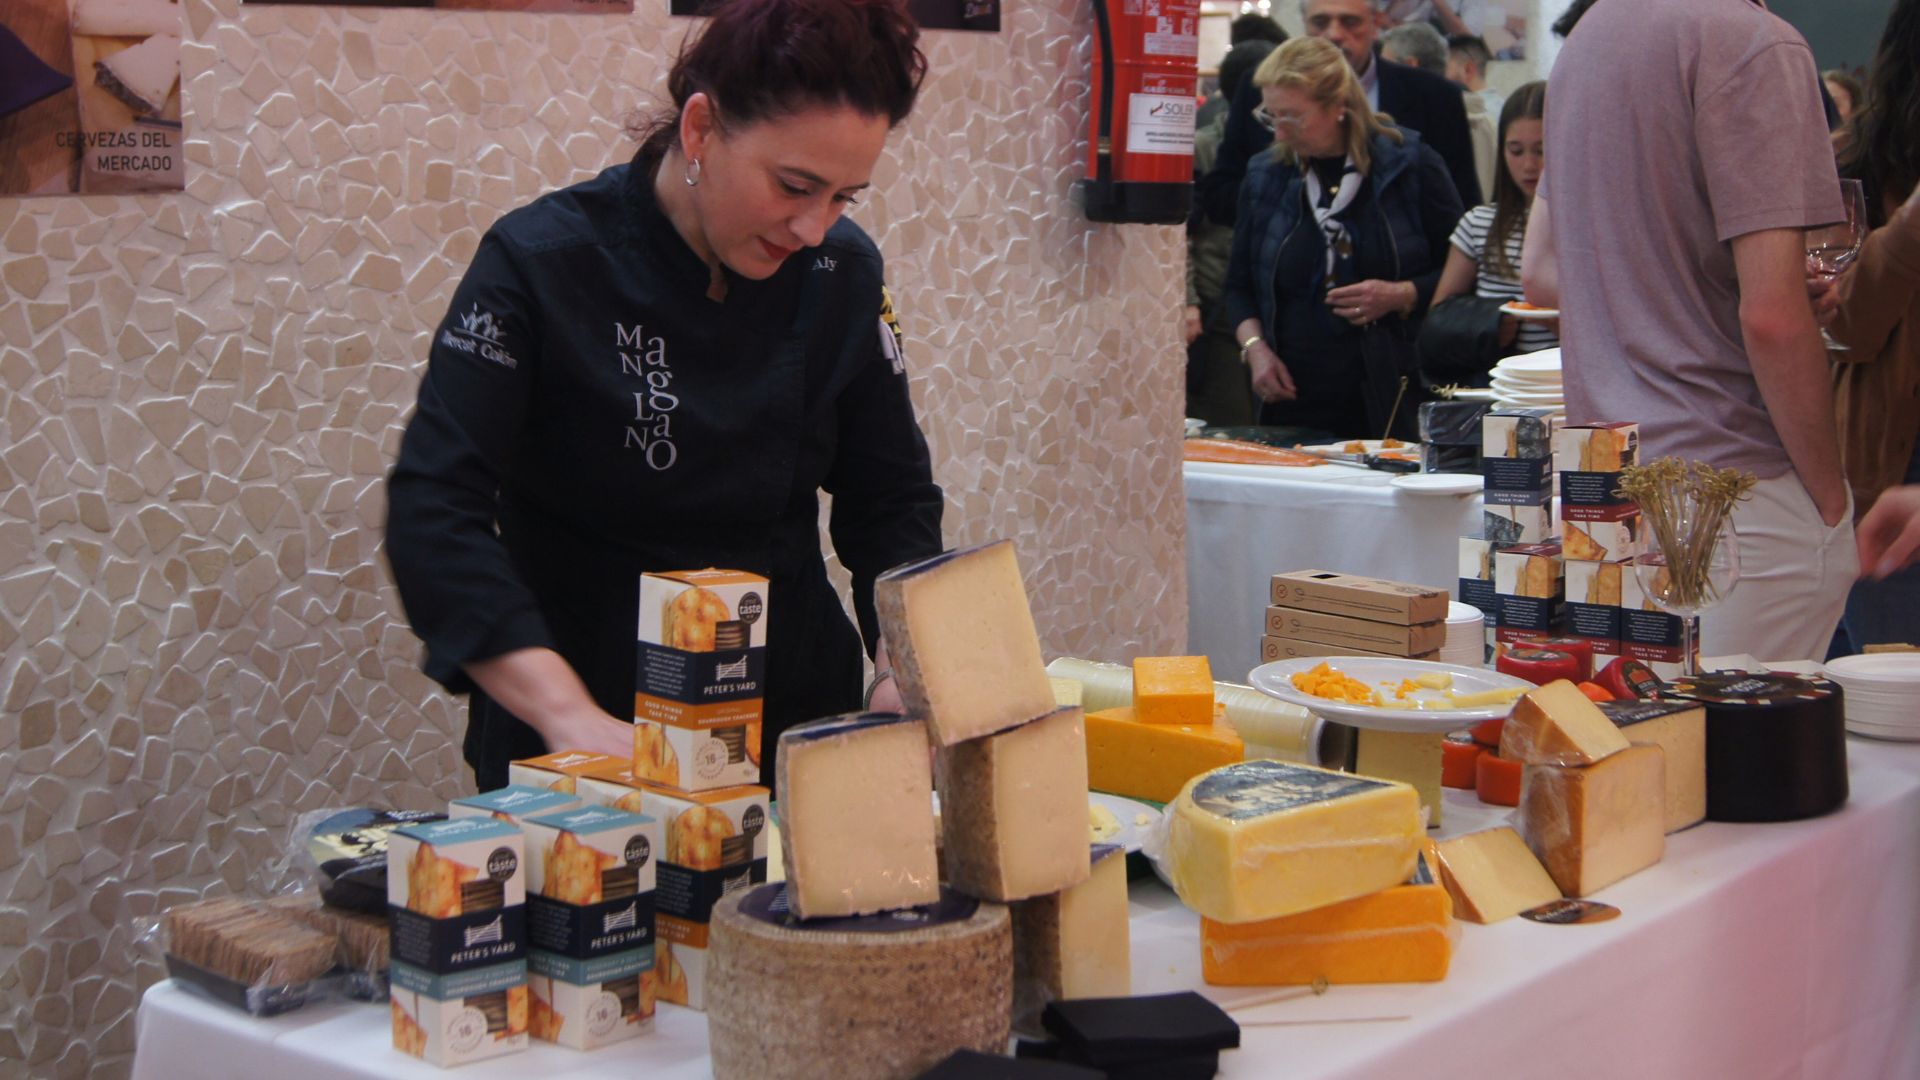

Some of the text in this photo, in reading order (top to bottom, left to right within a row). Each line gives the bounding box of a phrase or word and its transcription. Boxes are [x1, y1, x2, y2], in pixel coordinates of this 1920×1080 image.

[56, 132, 172, 148] CERVEZAS DEL
[97, 155, 172, 171] MERCADO
[812, 256, 838, 271] Aly
[740, 604, 762, 615] taste
[703, 681, 757, 696] PETER'S YARD
[591, 933, 625, 950] PETER'S
[626, 927, 648, 943] YARD
[450, 941, 517, 964] PETER'S YARD
